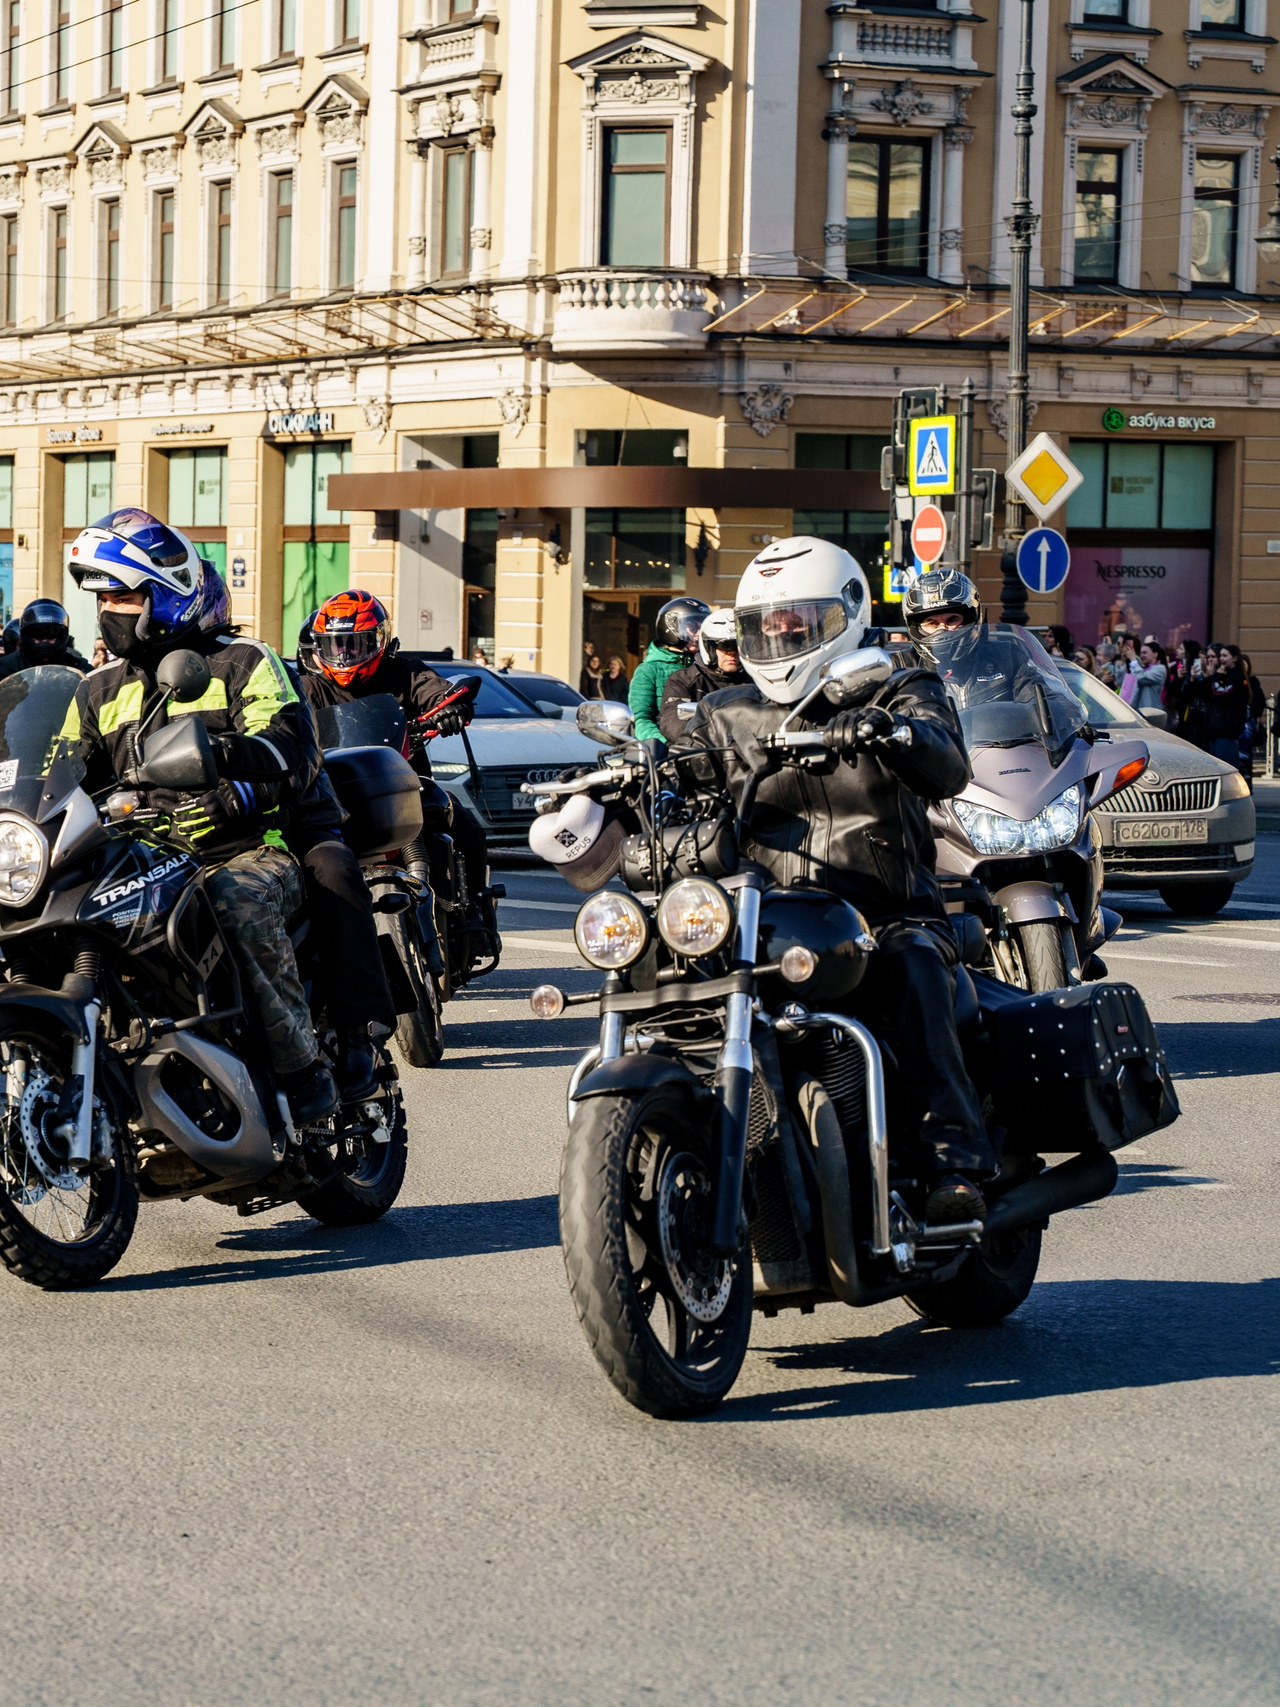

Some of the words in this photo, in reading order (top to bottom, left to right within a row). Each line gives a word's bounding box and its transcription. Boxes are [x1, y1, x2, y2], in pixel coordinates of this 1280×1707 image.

[1129, 412, 1175, 431] азбука
[1177, 416, 1216, 432] вкуса
[922, 600, 949, 610] SHARK
[1181, 819, 1205, 835] 178
[565, 835, 592, 860] REPUS
[92, 853, 190, 907] TRANSALP
